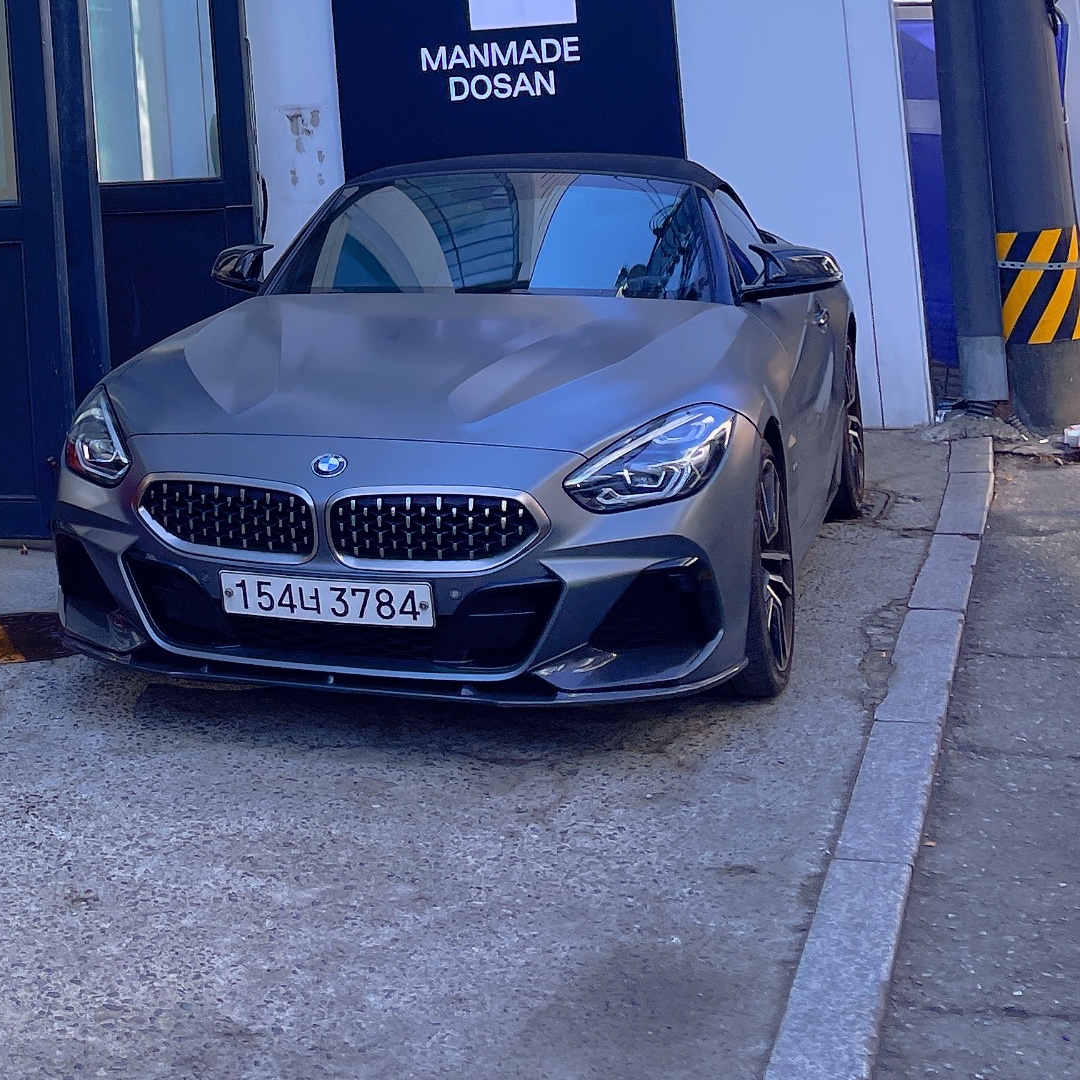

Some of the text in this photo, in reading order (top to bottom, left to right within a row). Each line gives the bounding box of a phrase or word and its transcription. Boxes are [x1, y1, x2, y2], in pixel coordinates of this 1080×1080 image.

[420, 36, 581, 71] MANMADE
[448, 70, 556, 101] DOSAN
[235, 579, 421, 621] 154너 3784
